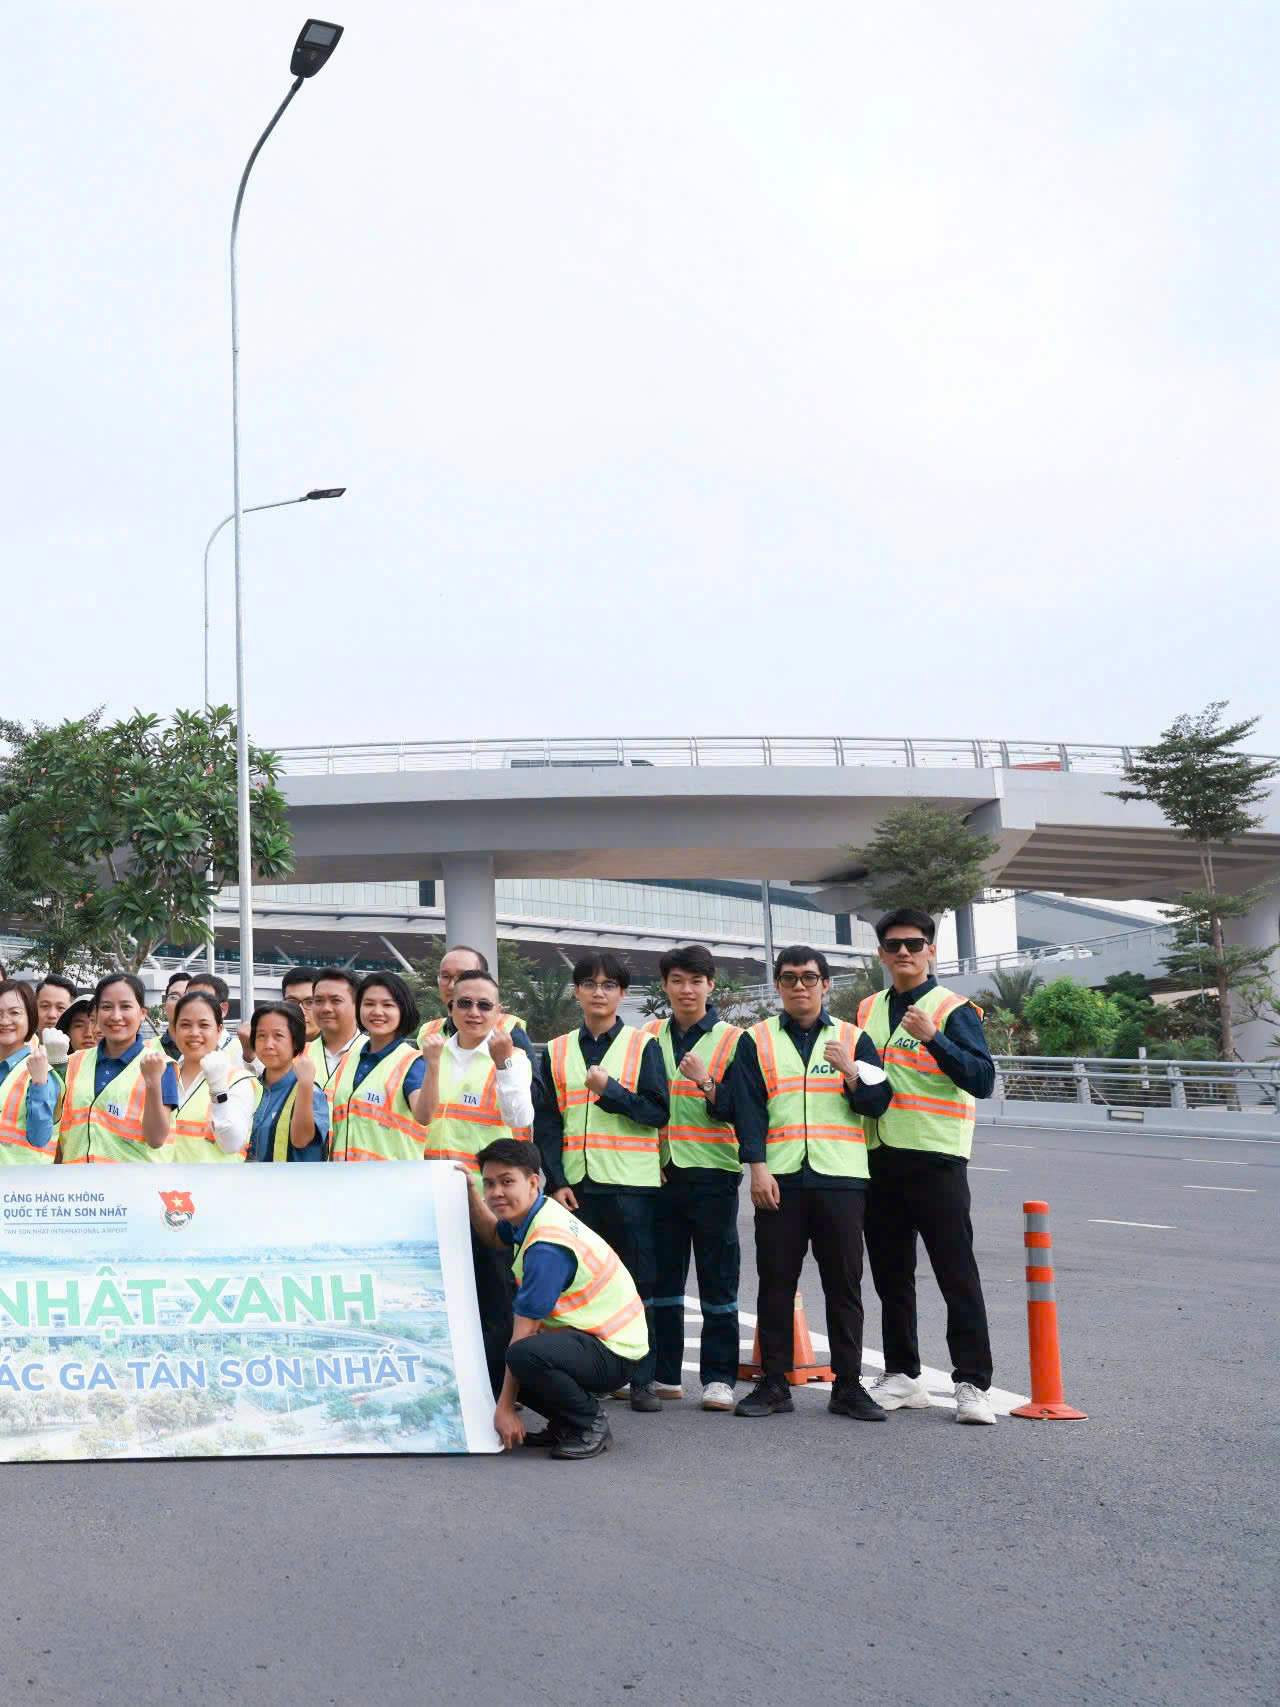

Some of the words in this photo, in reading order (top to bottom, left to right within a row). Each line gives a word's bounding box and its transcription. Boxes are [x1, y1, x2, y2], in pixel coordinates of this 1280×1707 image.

[894, 1037, 919, 1049] ACV
[463, 1094, 477, 1105] TIA
[107, 1103, 120, 1116] TIA
[3, 1190, 32, 1203] CẢNG
[35, 1191, 65, 1203] HÀNG
[68, 1190, 105, 1202] KHÔNG
[3, 1204, 32, 1219] QUỐC
[35, 1204, 48, 1217] TẾ
[51, 1205, 72, 1217] TÂN
[74, 1206, 97, 1217] SƠN
[99, 1203, 128, 1217] NHẤT
[184, 1273, 377, 1325] XANH
[59, 1361, 117, 1391] GA
[127, 1353, 207, 1390] TÂN
[220, 1355, 304, 1388] SƠN
[316, 1342, 421, 1386] NHẤT
